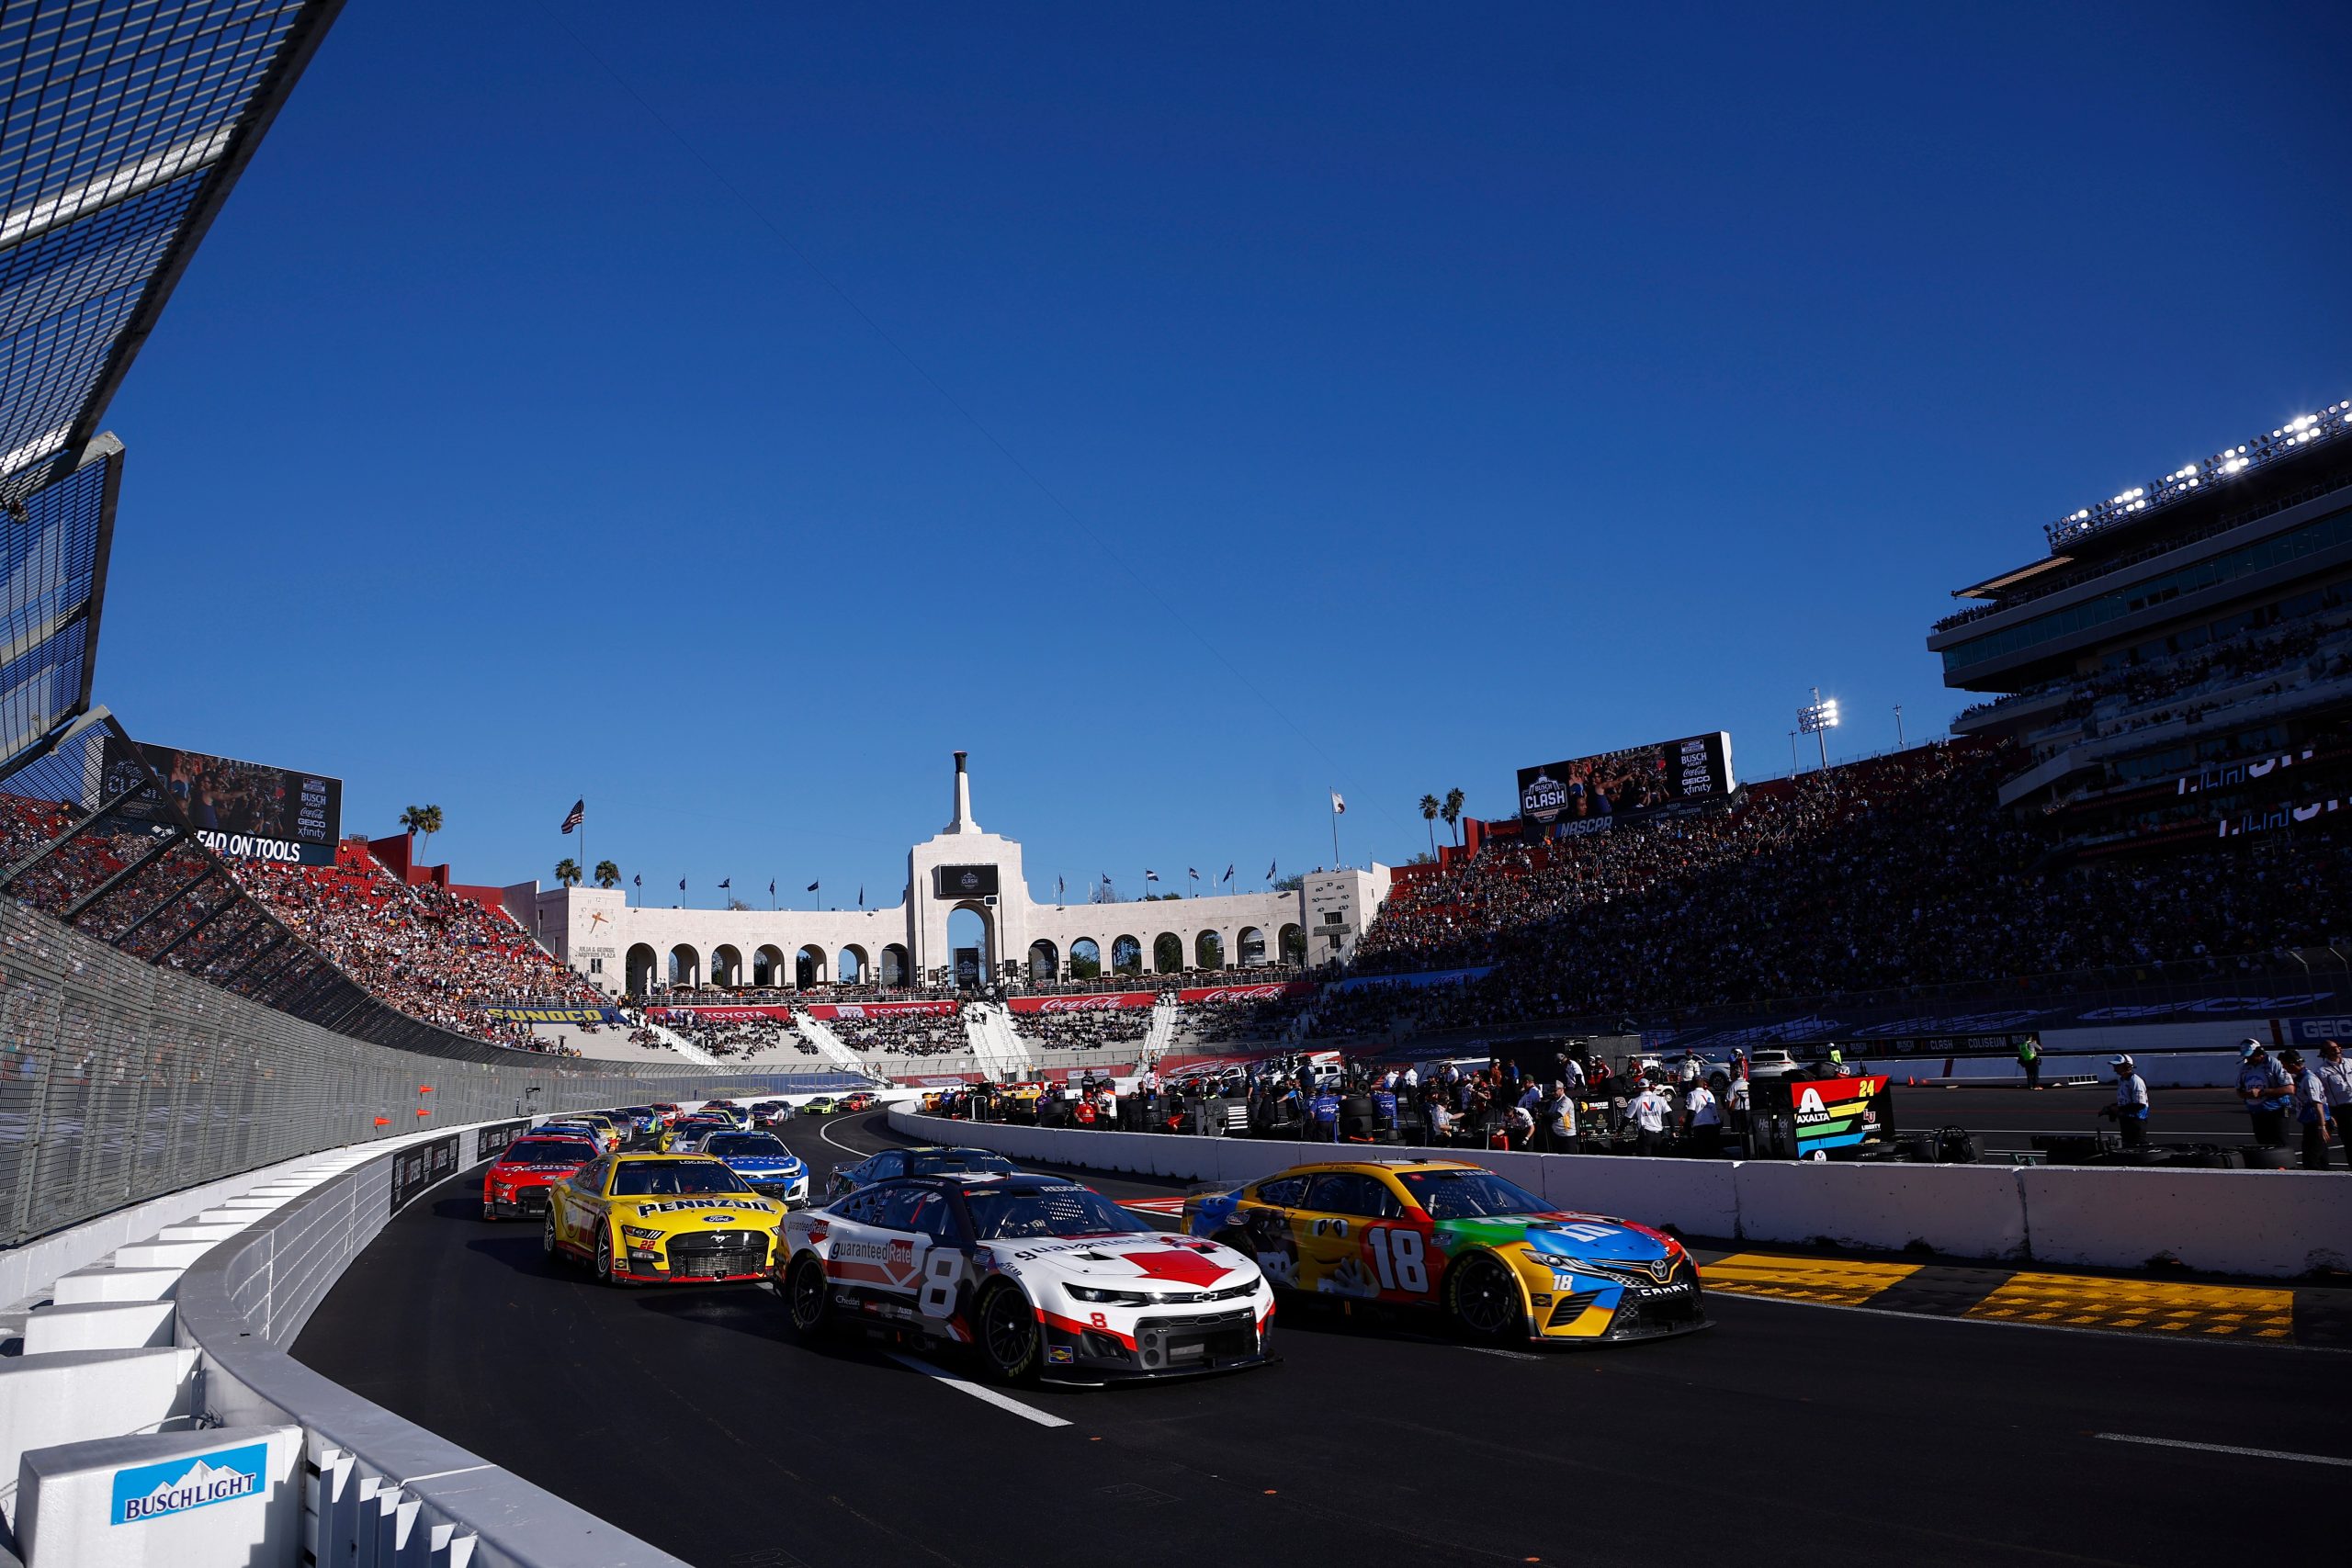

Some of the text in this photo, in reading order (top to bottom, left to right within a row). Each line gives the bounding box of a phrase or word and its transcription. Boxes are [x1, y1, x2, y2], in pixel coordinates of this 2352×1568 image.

[1681, 752, 1708, 764] BUSCH
[1534, 782, 1553, 792] BUSCH
[1681, 775, 1711, 785] GEICO
[1683, 783, 1712, 795] xfinity
[300, 792, 327, 806] BUSCH
[1525, 790, 1566, 809] CLASH
[298, 818, 326, 829] GEICO
[1560, 816, 1613, 838] NASCAR
[297, 826, 326, 840] xfinity
[230, 836, 254, 856] ON
[255, 838, 301, 863] TOOLS
[487, 1008, 604, 1021] SUNOCO
[702, 1009, 768, 1020] TOYOTA
[2301, 1021, 2352, 1039] GEIC
[1929, 1039, 1953, 1050] CLASH
[1967, 1036, 2007, 1048] COLISEUM
[1859, 1079, 1875, 1098] 24
[1796, 1112, 1830, 1124] AXALTA
[637, 1198, 779, 1219] PENNZOIL
[708, 1214, 730, 1223] Ford
[639, 1240, 656, 1251] 22
[1366, 1226, 1430, 1293] 18
[919, 1247, 964, 1319] 8
[1552, 1274, 1574, 1292] 18
[1640, 1283, 1690, 1297] CAMRY
[1090, 1312, 1108, 1329] 8
